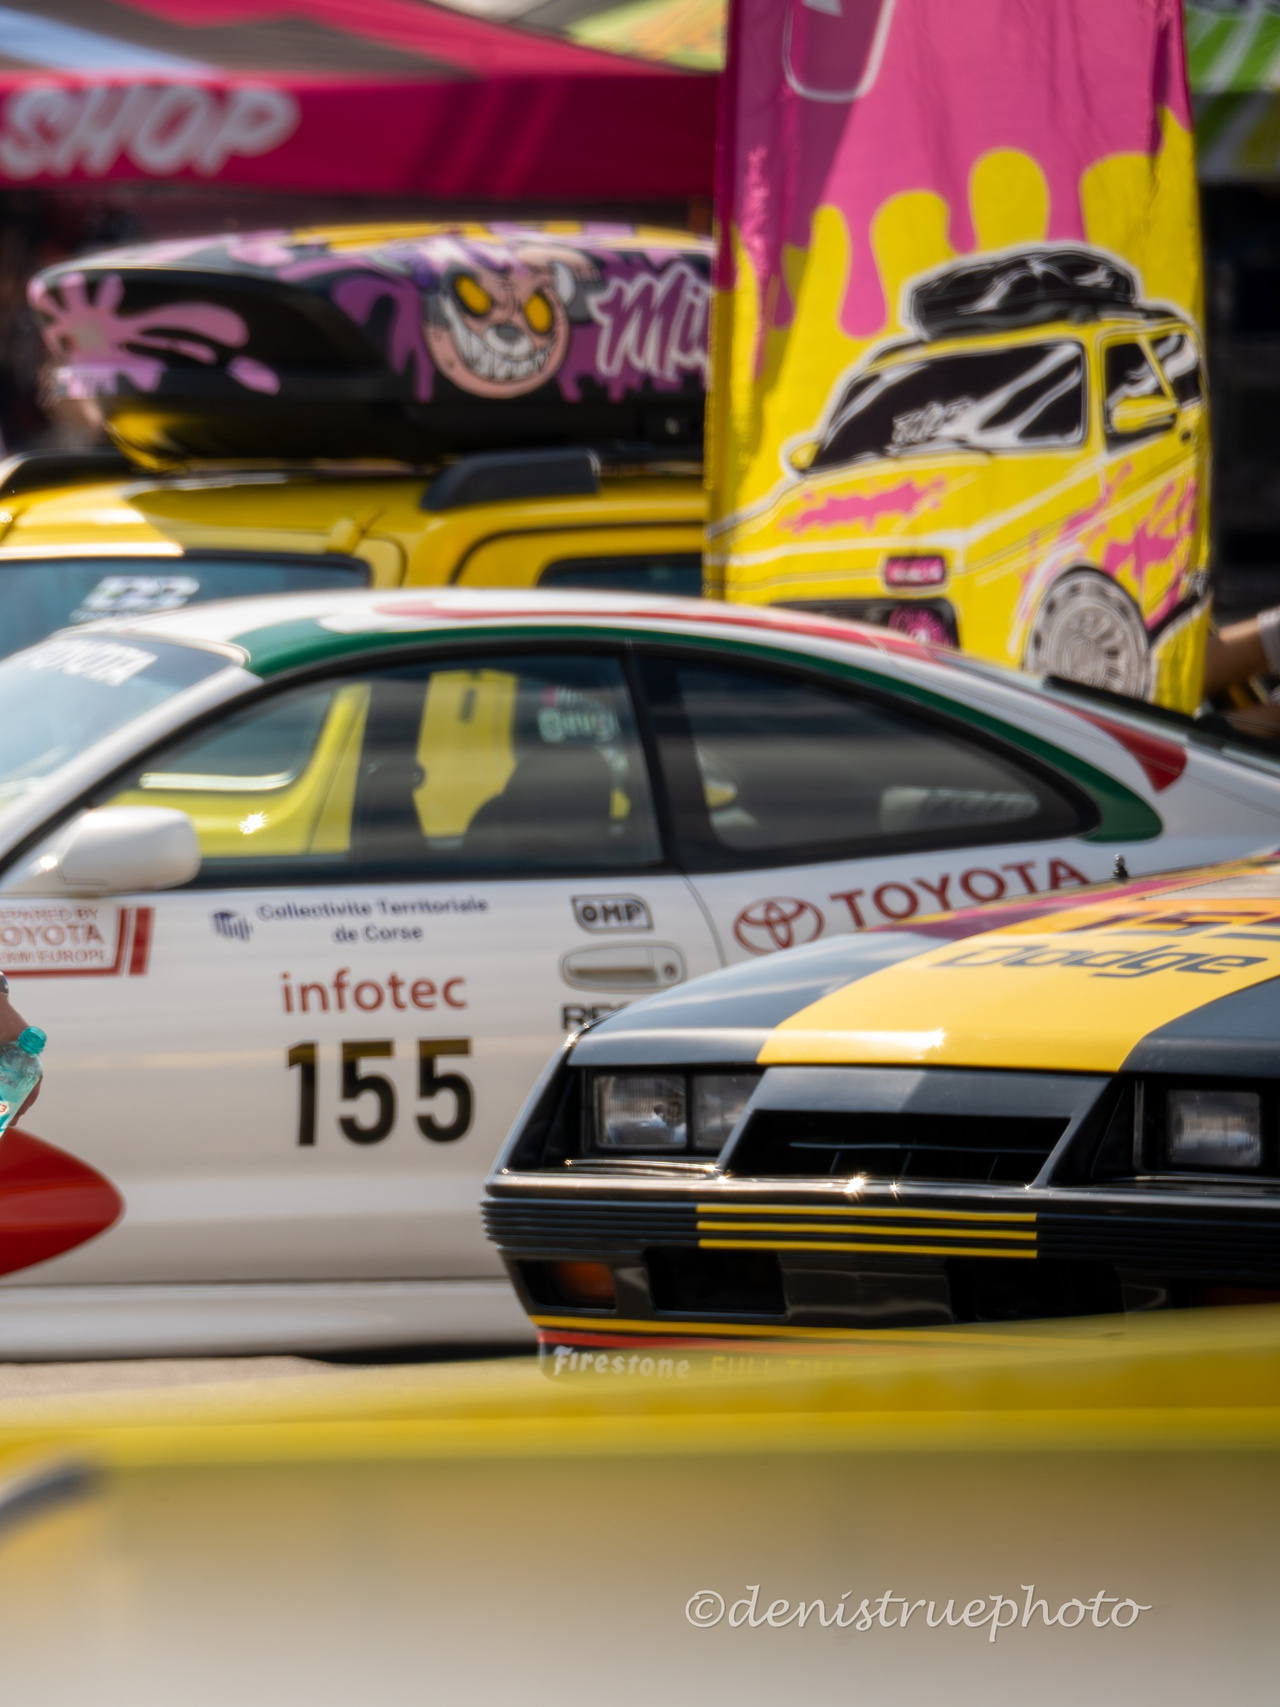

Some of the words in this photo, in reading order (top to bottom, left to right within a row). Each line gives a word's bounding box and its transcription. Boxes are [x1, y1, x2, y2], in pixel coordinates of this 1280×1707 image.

[380, 896, 488, 915] Territoriale
[829, 857, 1089, 931] TOYOTA
[581, 902, 642, 923] OMP
[334, 925, 357, 942] de
[364, 924, 423, 942] Corse
[932, 945, 1269, 978] Dodge
[281, 967, 468, 1013] infotec
[287, 1037, 475, 1147] 155
[553, 1346, 691, 1379] Firestone
